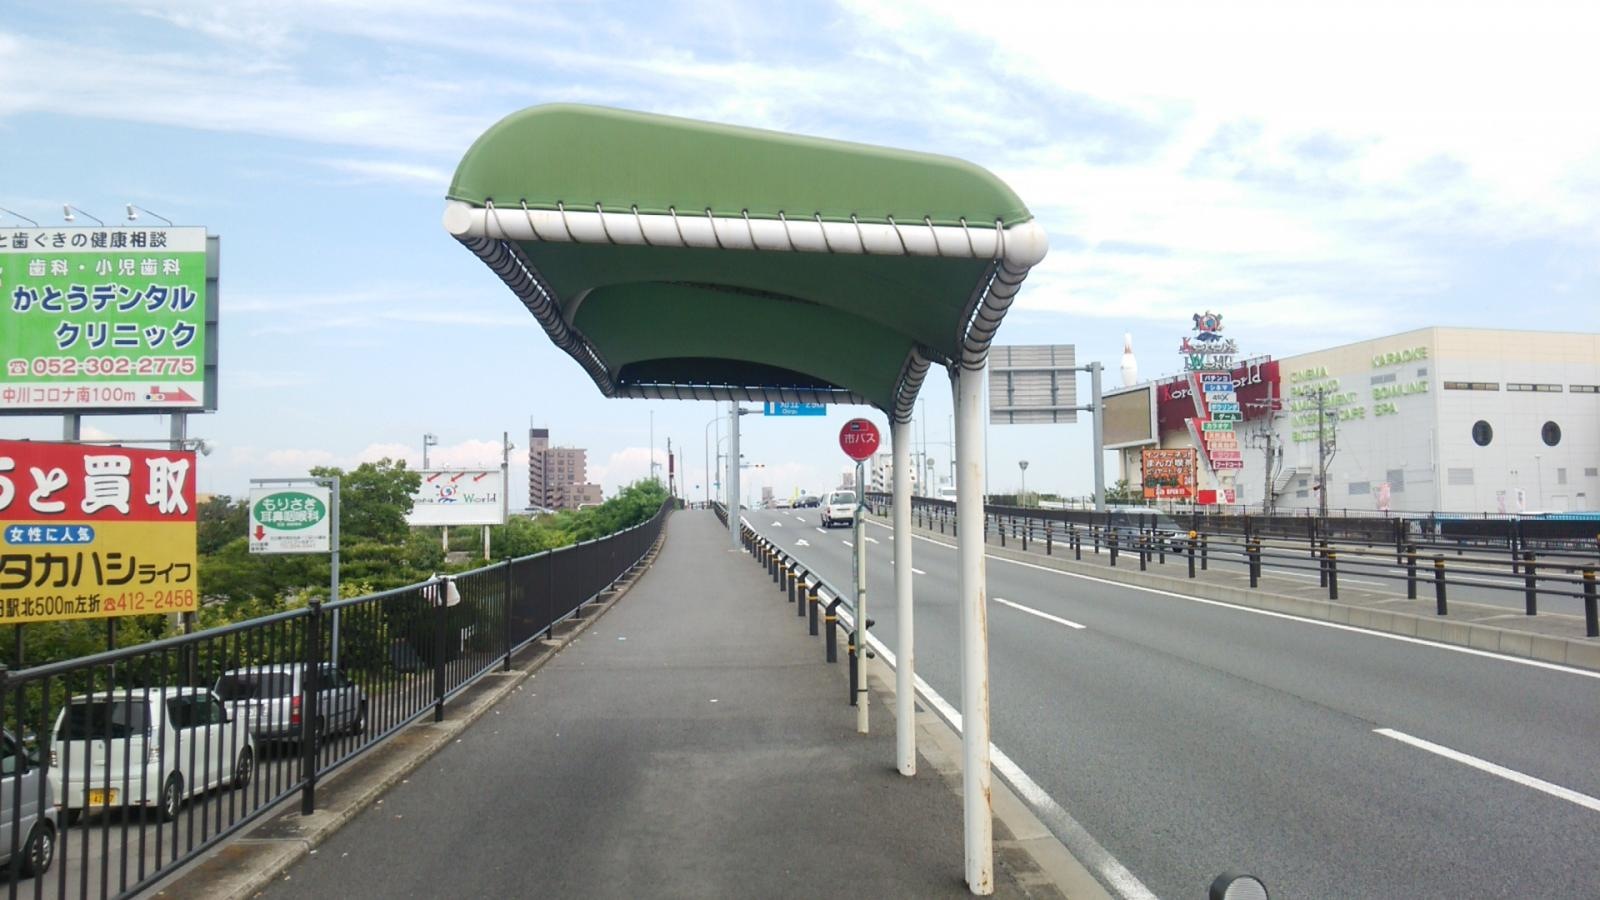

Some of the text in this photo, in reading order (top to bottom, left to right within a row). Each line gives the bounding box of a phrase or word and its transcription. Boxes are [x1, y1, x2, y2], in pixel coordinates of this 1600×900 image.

[29, 258, 181, 276] 歯科・小児歯科
[13, 285, 197, 312] かとうデンタル
[56, 321, 197, 349] クリニック
[33, 357, 195, 375] 052-302-2775
[1232, 363, 1263, 388] orld
[3, 386, 136, 403] 中川コロナ南100m
[844, 433, 876, 444] 市バス
[262, 497, 318, 511] もりさき
[464, 492, 497, 503] World
[10, 526, 91, 542] 女性に人気
[0, 551, 191, 590] タカハシライフ
[0, 594, 100, 619] 駅北500m左折
